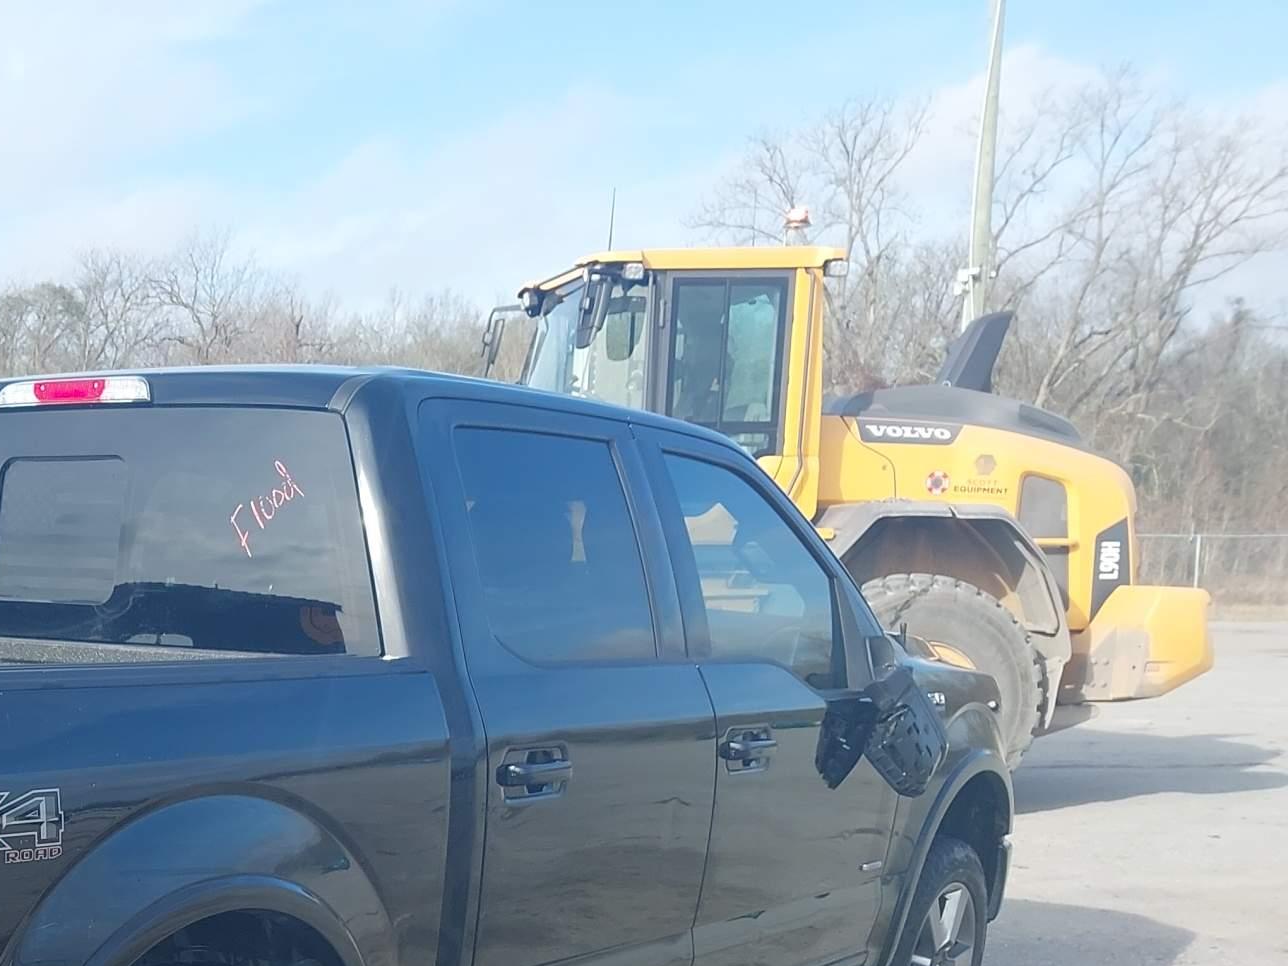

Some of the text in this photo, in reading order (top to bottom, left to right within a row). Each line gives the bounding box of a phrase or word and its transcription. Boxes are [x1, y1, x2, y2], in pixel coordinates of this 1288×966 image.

[865, 424, 952, 440] VOLVO
[953, 485, 1009, 495] EQUIPMENT
[1098, 541, 1121, 580] L90H
[4, 846, 63, 864] ROAD
